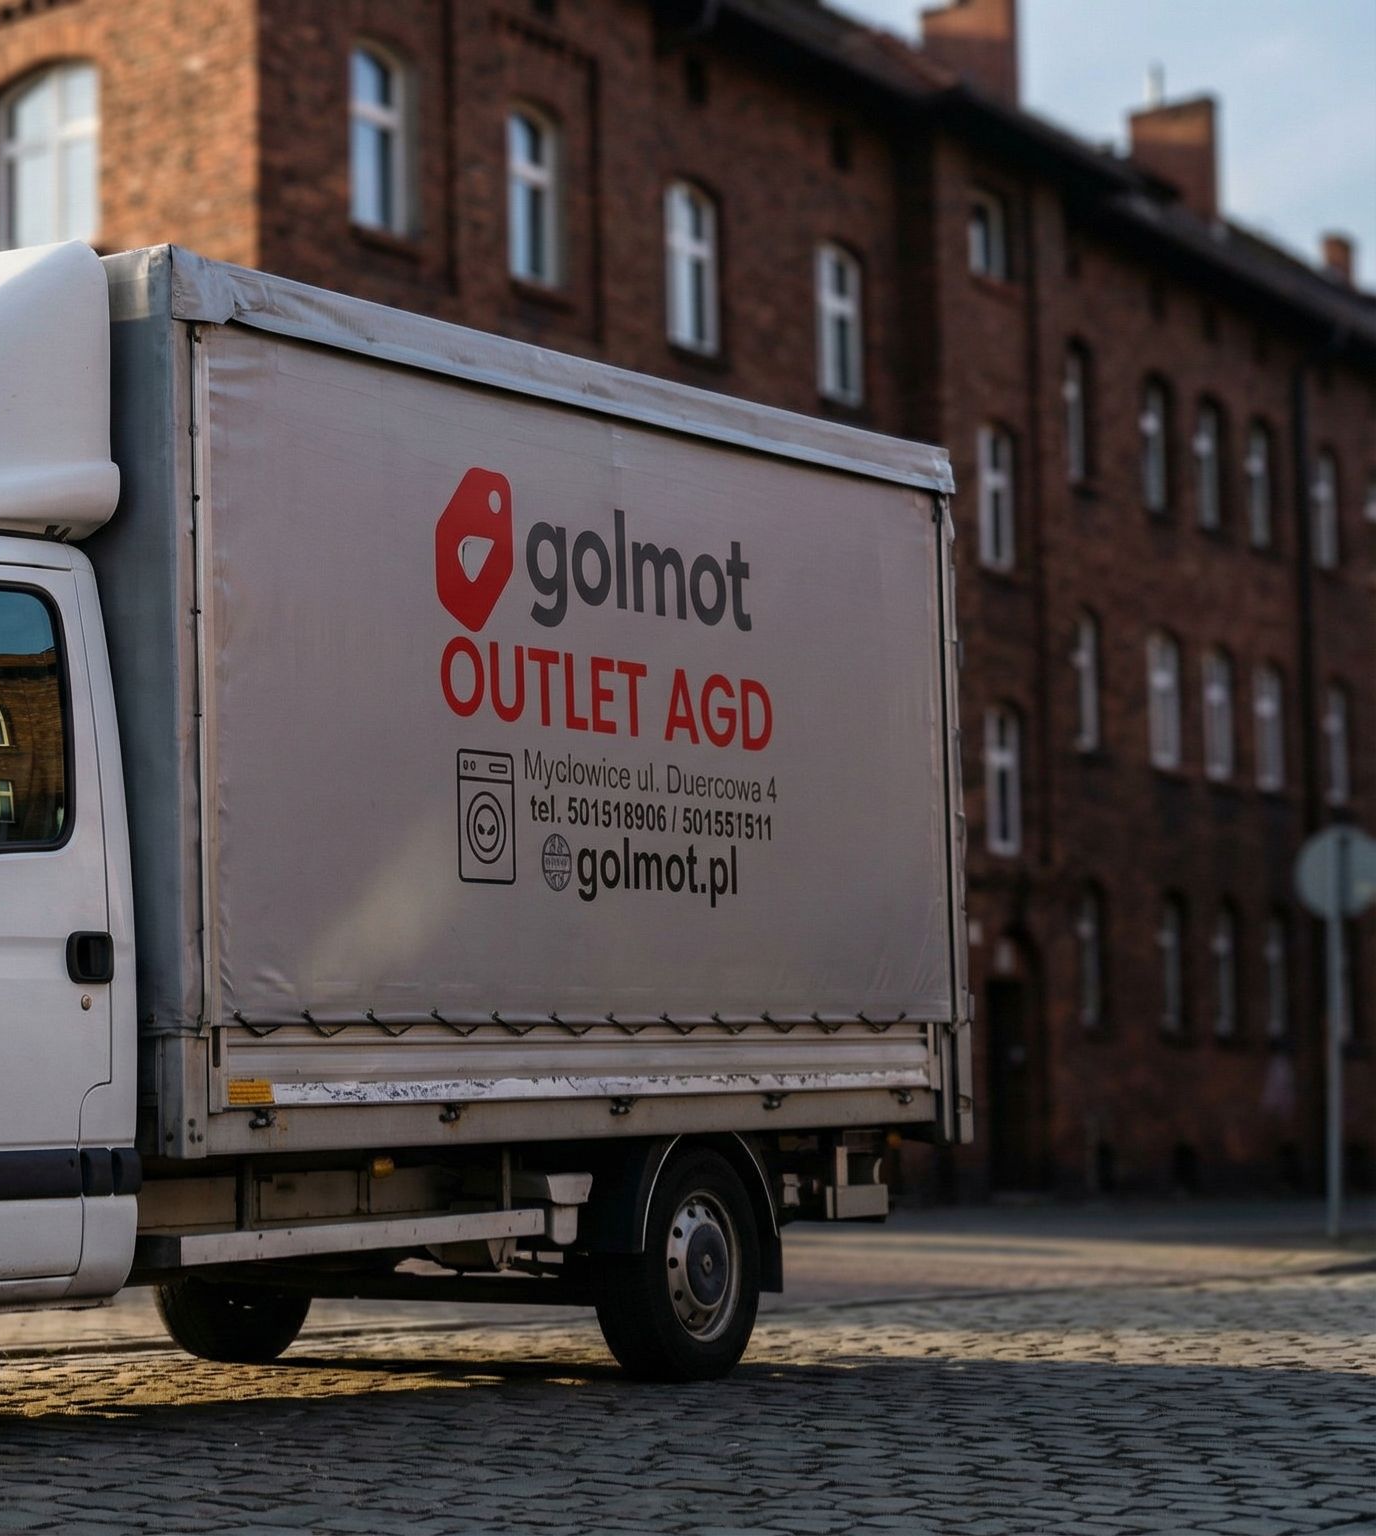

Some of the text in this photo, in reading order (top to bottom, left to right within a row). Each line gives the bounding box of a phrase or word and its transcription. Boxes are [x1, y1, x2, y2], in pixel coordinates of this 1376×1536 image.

[526, 509, 753, 631] golmot
[441, 636, 773, 751] OUTLET AGD
[530, 795, 773, 841] tel. 501518906 / 501551511
[637, 763, 660, 793] ul.
[667, 765, 762, 803] Duercowa
[766, 776, 778, 804] 4
[577, 837, 738, 909] golmot.pl
